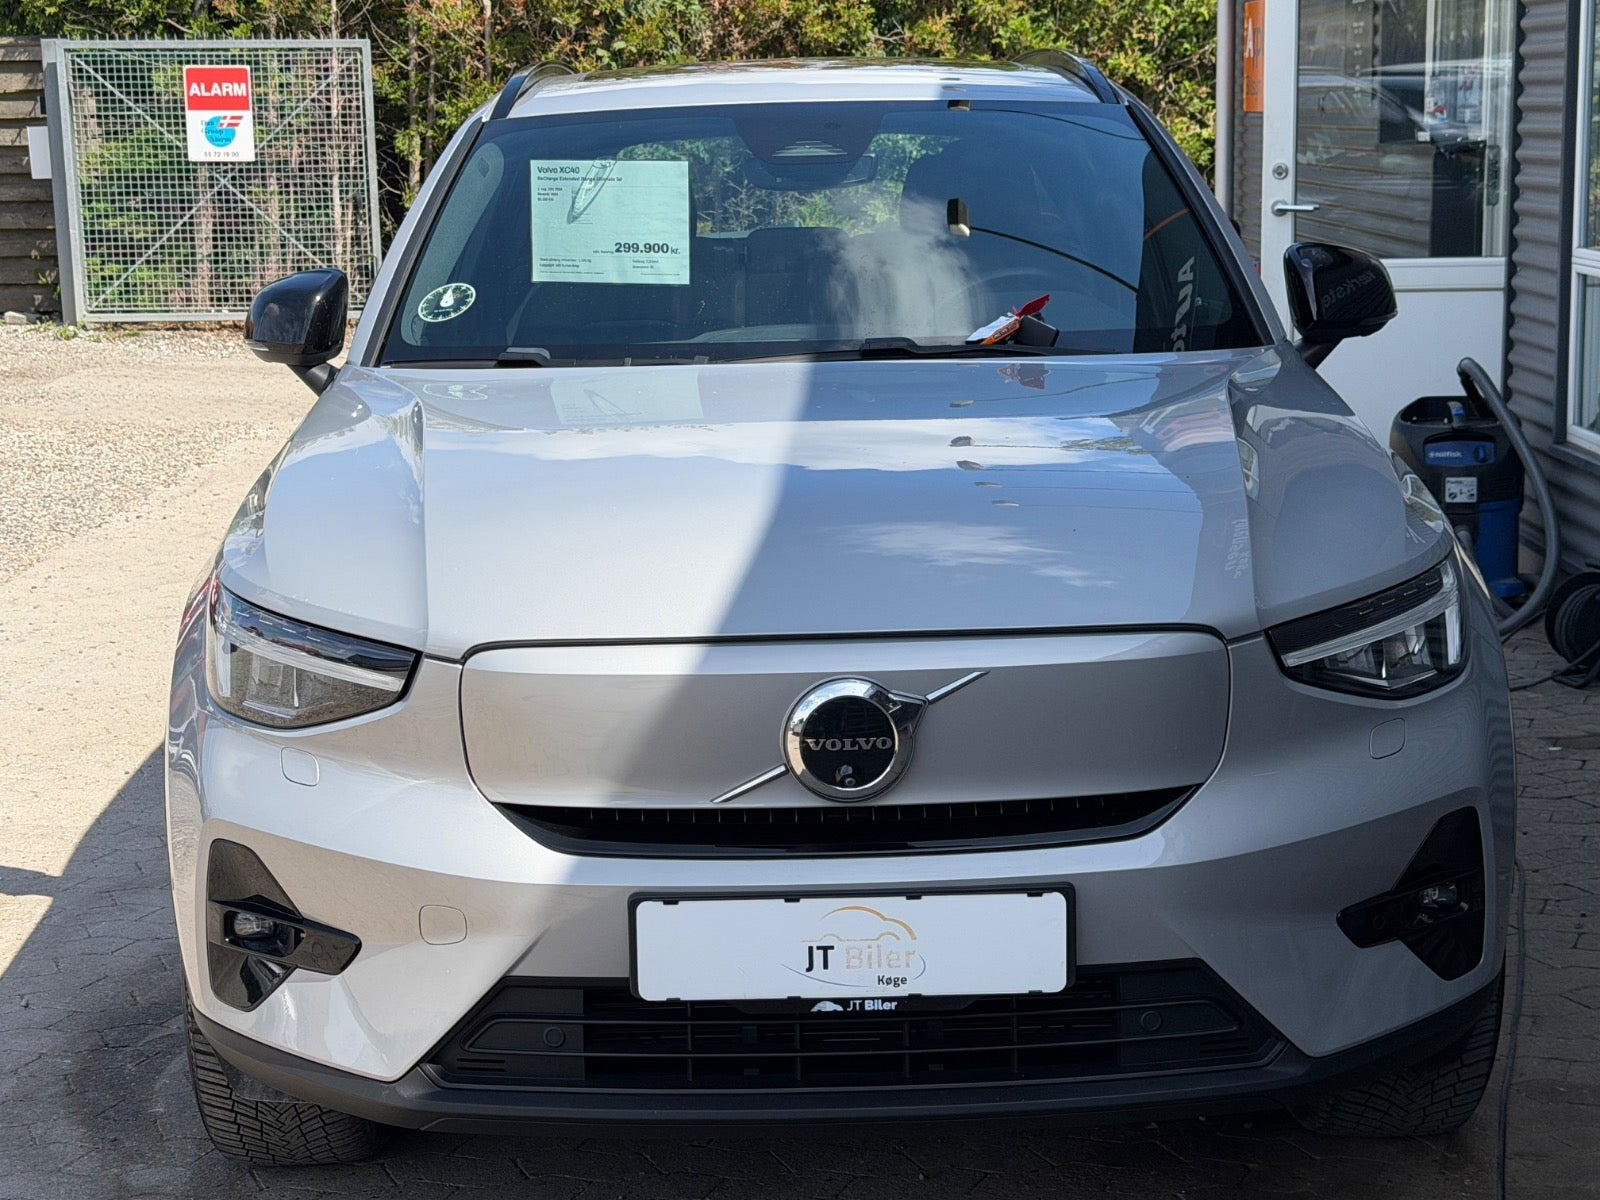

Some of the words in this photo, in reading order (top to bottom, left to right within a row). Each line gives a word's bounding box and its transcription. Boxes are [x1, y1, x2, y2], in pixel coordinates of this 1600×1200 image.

[189, 82, 247, 97] ALARM
[537, 166, 558, 174] Volvo
[559, 166, 580, 174] XC40
[614, 242, 670, 254] 299.900
[671, 246, 681, 255] kr.
[805, 737, 893, 751] VOLVO
[805, 945, 835, 973] JT
[845, 944, 916, 970] Biler
[877, 975, 908, 988] Køge
[847, 1000, 862, 1011] JT
[864, 999, 898, 1011] Biler
